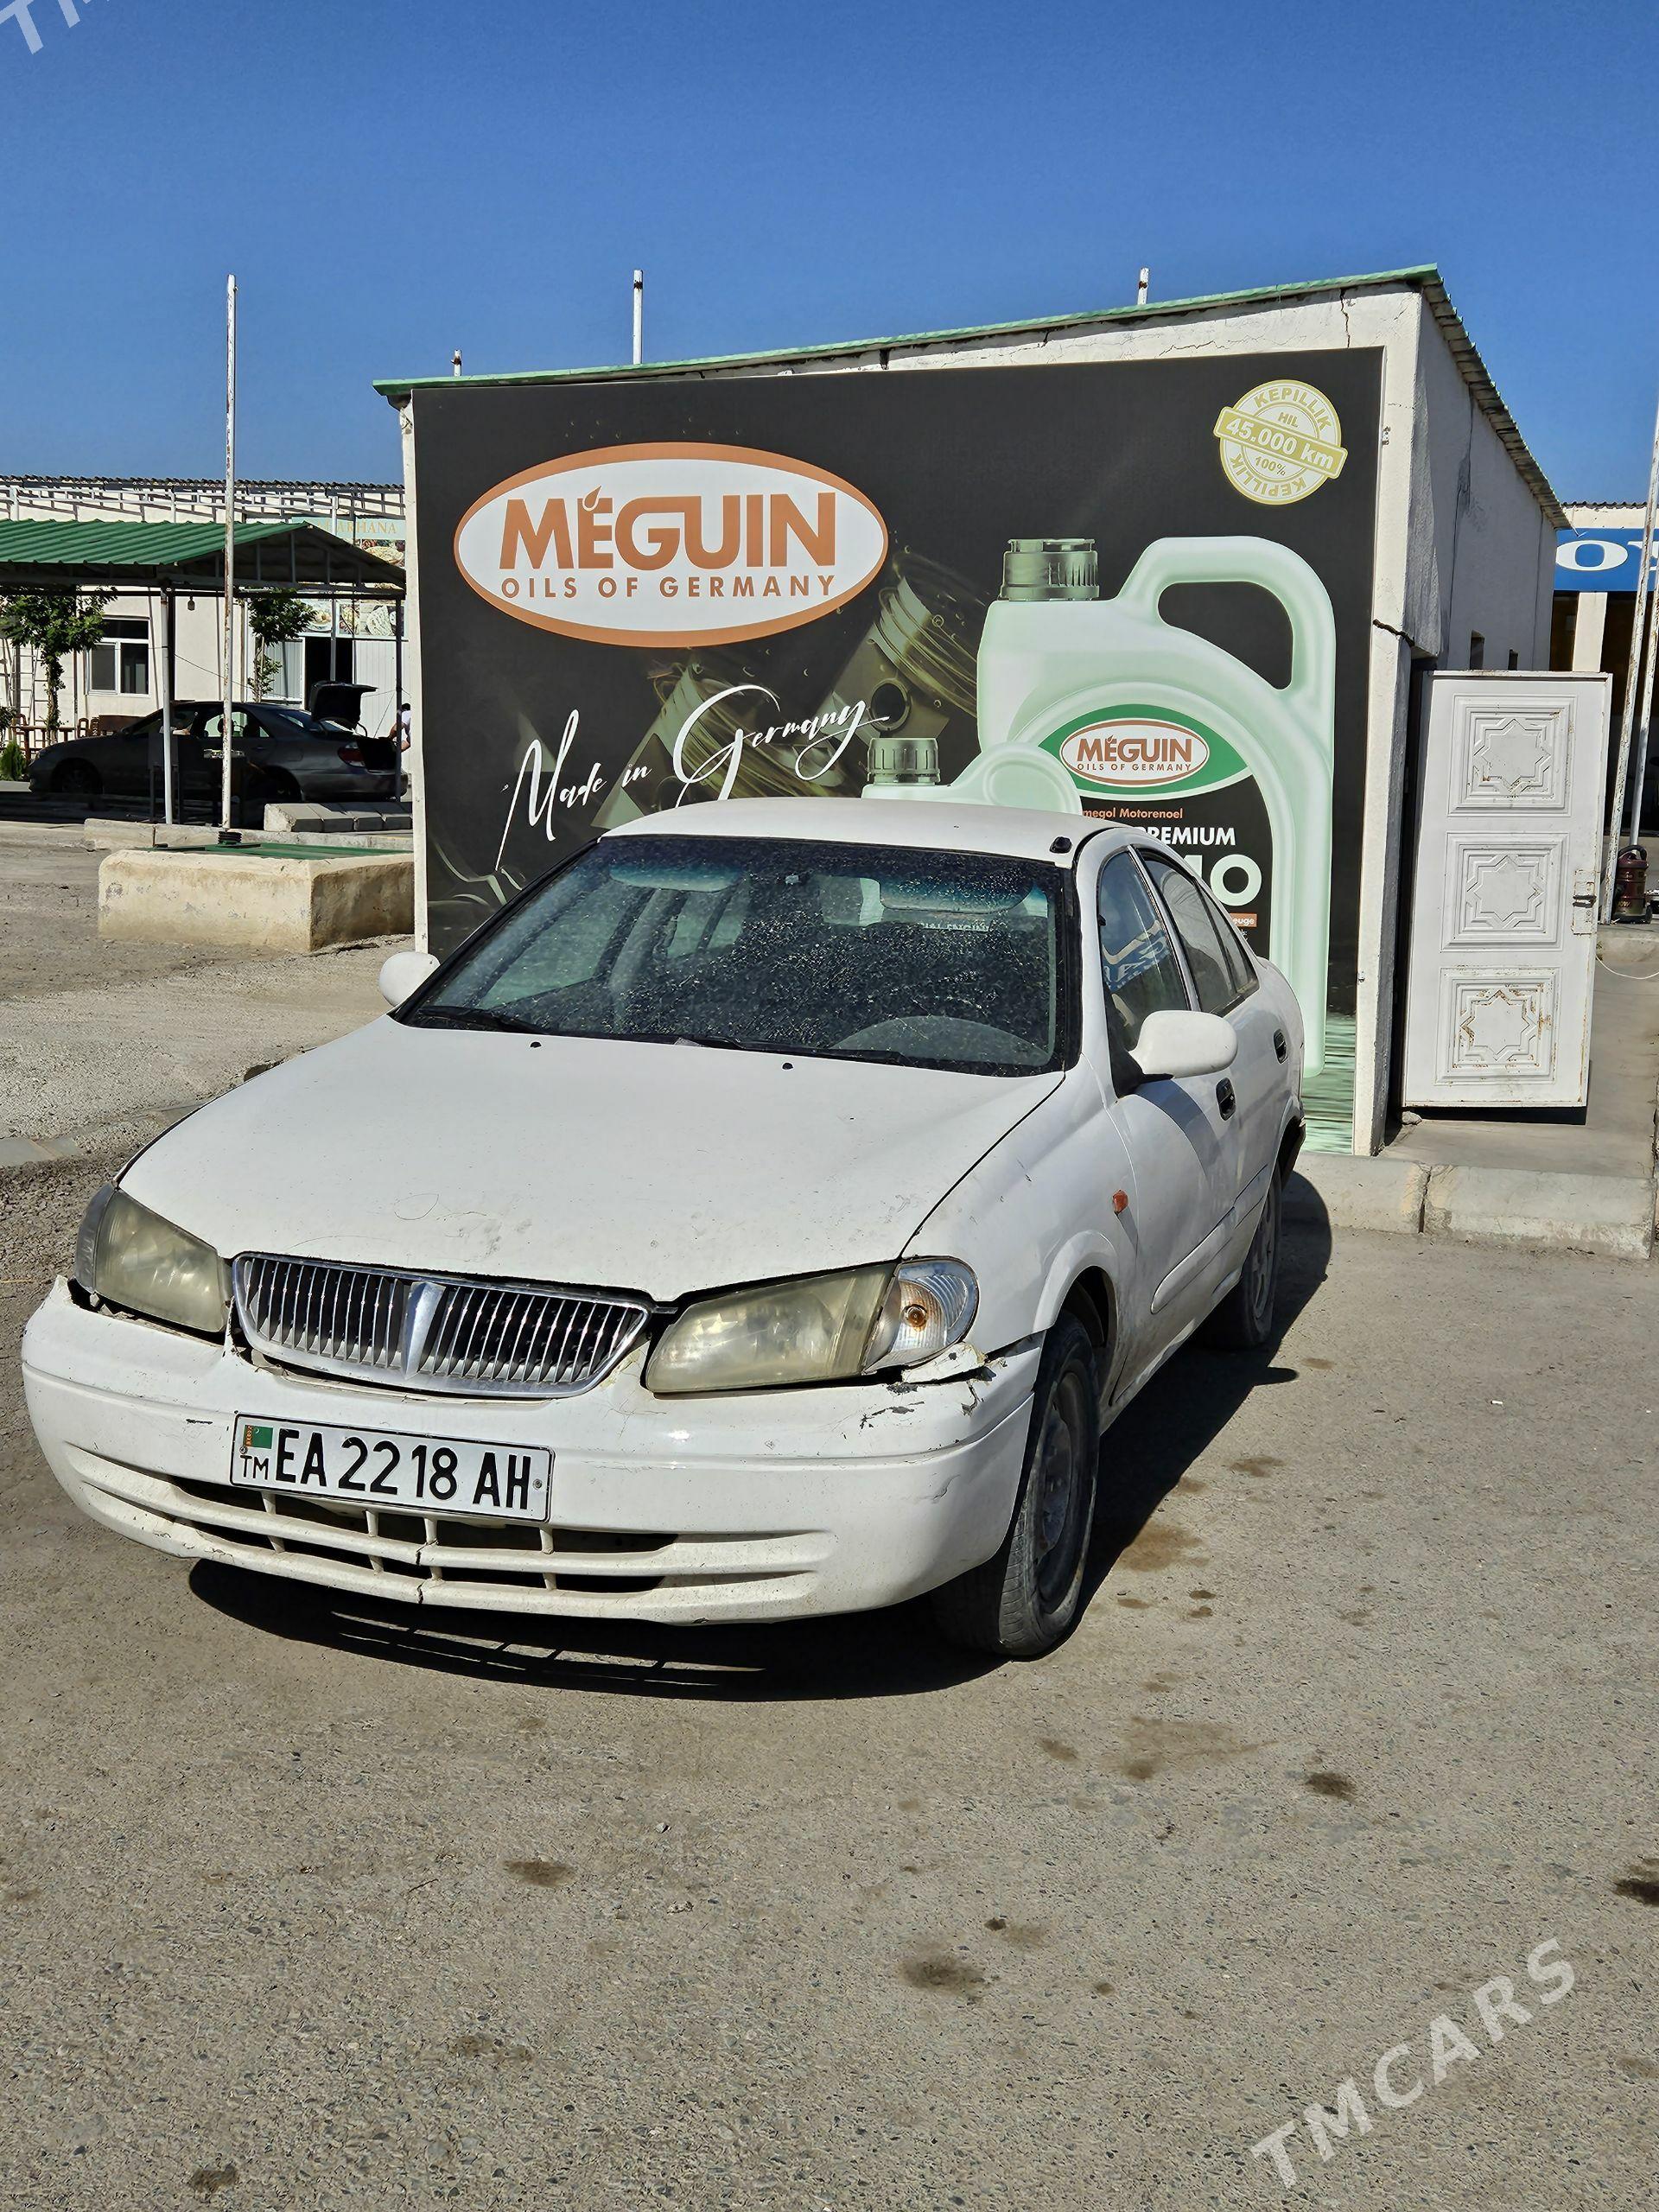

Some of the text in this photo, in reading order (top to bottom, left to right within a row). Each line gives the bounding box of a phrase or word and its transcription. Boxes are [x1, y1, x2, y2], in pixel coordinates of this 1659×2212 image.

[1254, 387, 1332, 432] KEPILLIK
[1225, 417, 1334, 470] 45.000 km
[1230, 453, 1307, 497] KEPILLIK
[1255, 455, 1287, 476] 100%
[499, 485, 836, 571] MÉGUIN
[501, 575, 836, 599] OILS OF GERMANY
[1077, 734, 1192, 763] MÉGUIN
[495, 684, 890, 871] Made in Germany
[1119, 807, 1184, 818] Motorenoel
[1134, 826, 1236, 845] REMIUM
[239, 1454, 270, 1481] TM
[276, 1427, 531, 1510] EA 2218 AH
